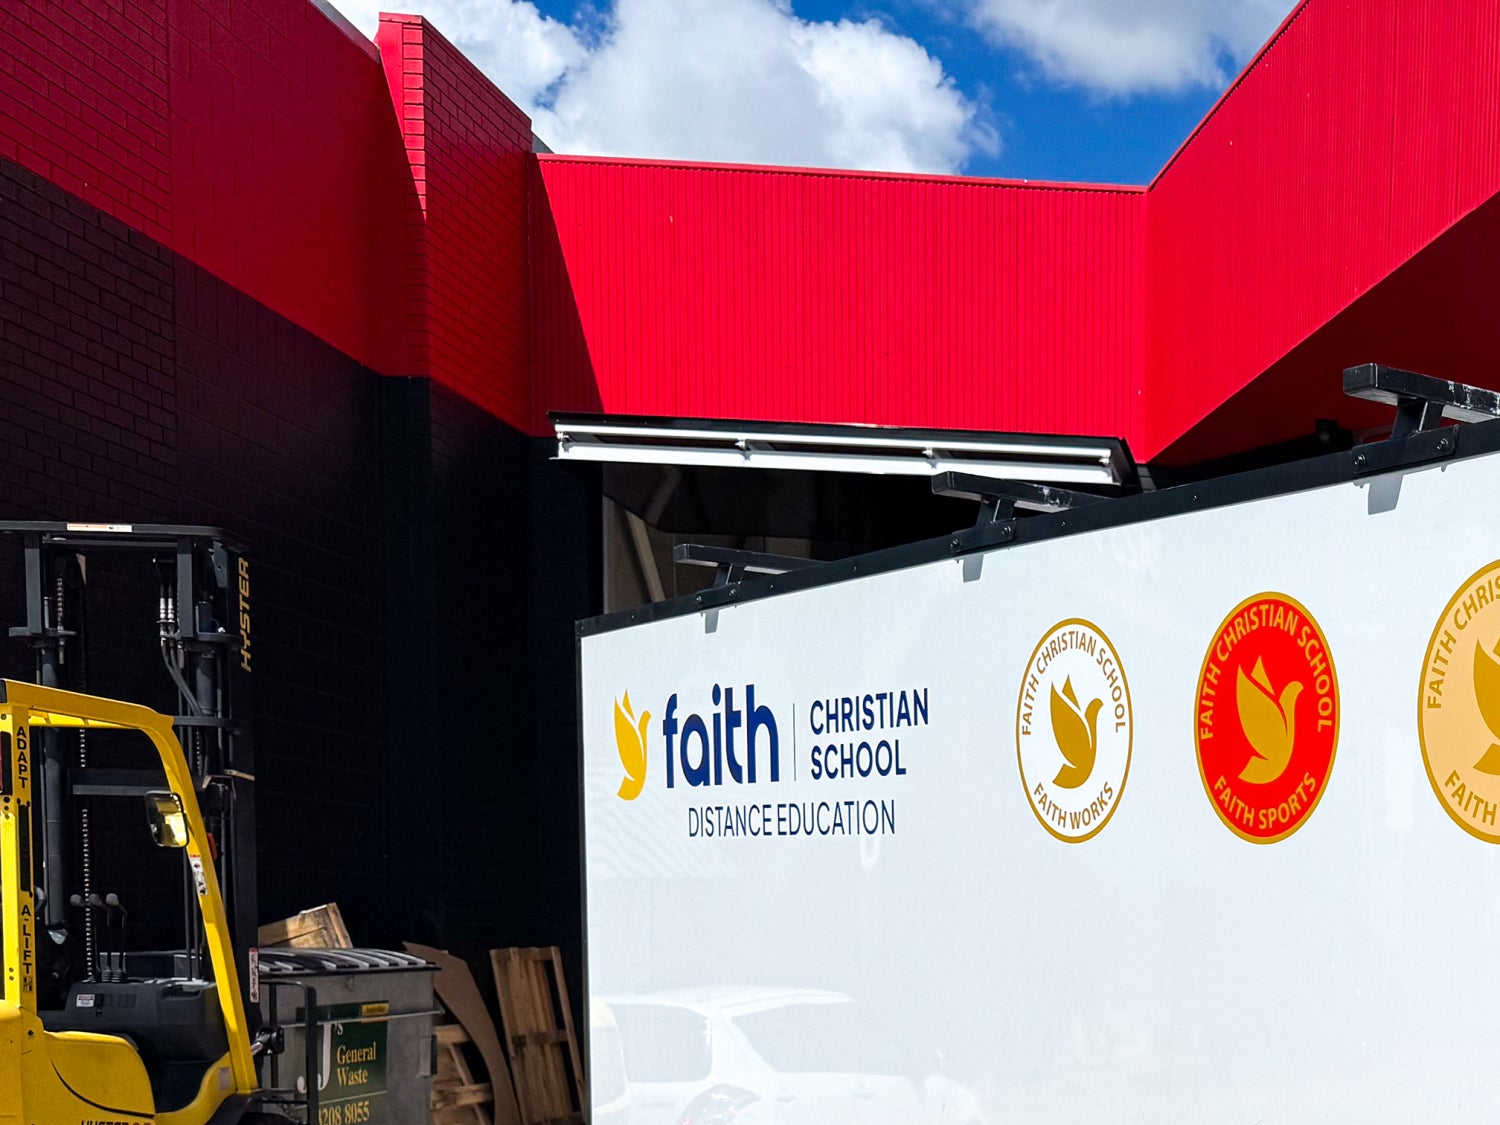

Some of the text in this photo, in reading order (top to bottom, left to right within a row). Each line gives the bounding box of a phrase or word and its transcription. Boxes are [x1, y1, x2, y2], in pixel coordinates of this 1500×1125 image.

[238, 557, 252, 673] HYSTER
[1022, 630, 1127, 736] FAITH CHRISTIAN SCHOOL
[1201, 604, 1333, 740] FAITH CHRISTIAN SCHOOL
[1427, 633, 1457, 709] FAITH
[662, 683, 780, 789] faith
[809, 688, 929, 736] CHRISTIAN
[16, 726, 28, 789] ADAPT
[810, 739, 907, 780] SCHOOL
[688, 798, 896, 838] DISTANCE EDUCATION
[1033, 780, 1115, 830] FAITH WORKS
[1213, 771, 1317, 830] FAITH SPORTS
[1444, 769, 1497, 828] FAITH
[337, 1042, 376, 1065] General
[337, 1067, 368, 1087] Waste
[344, 1101, 370, 1125] 8055
